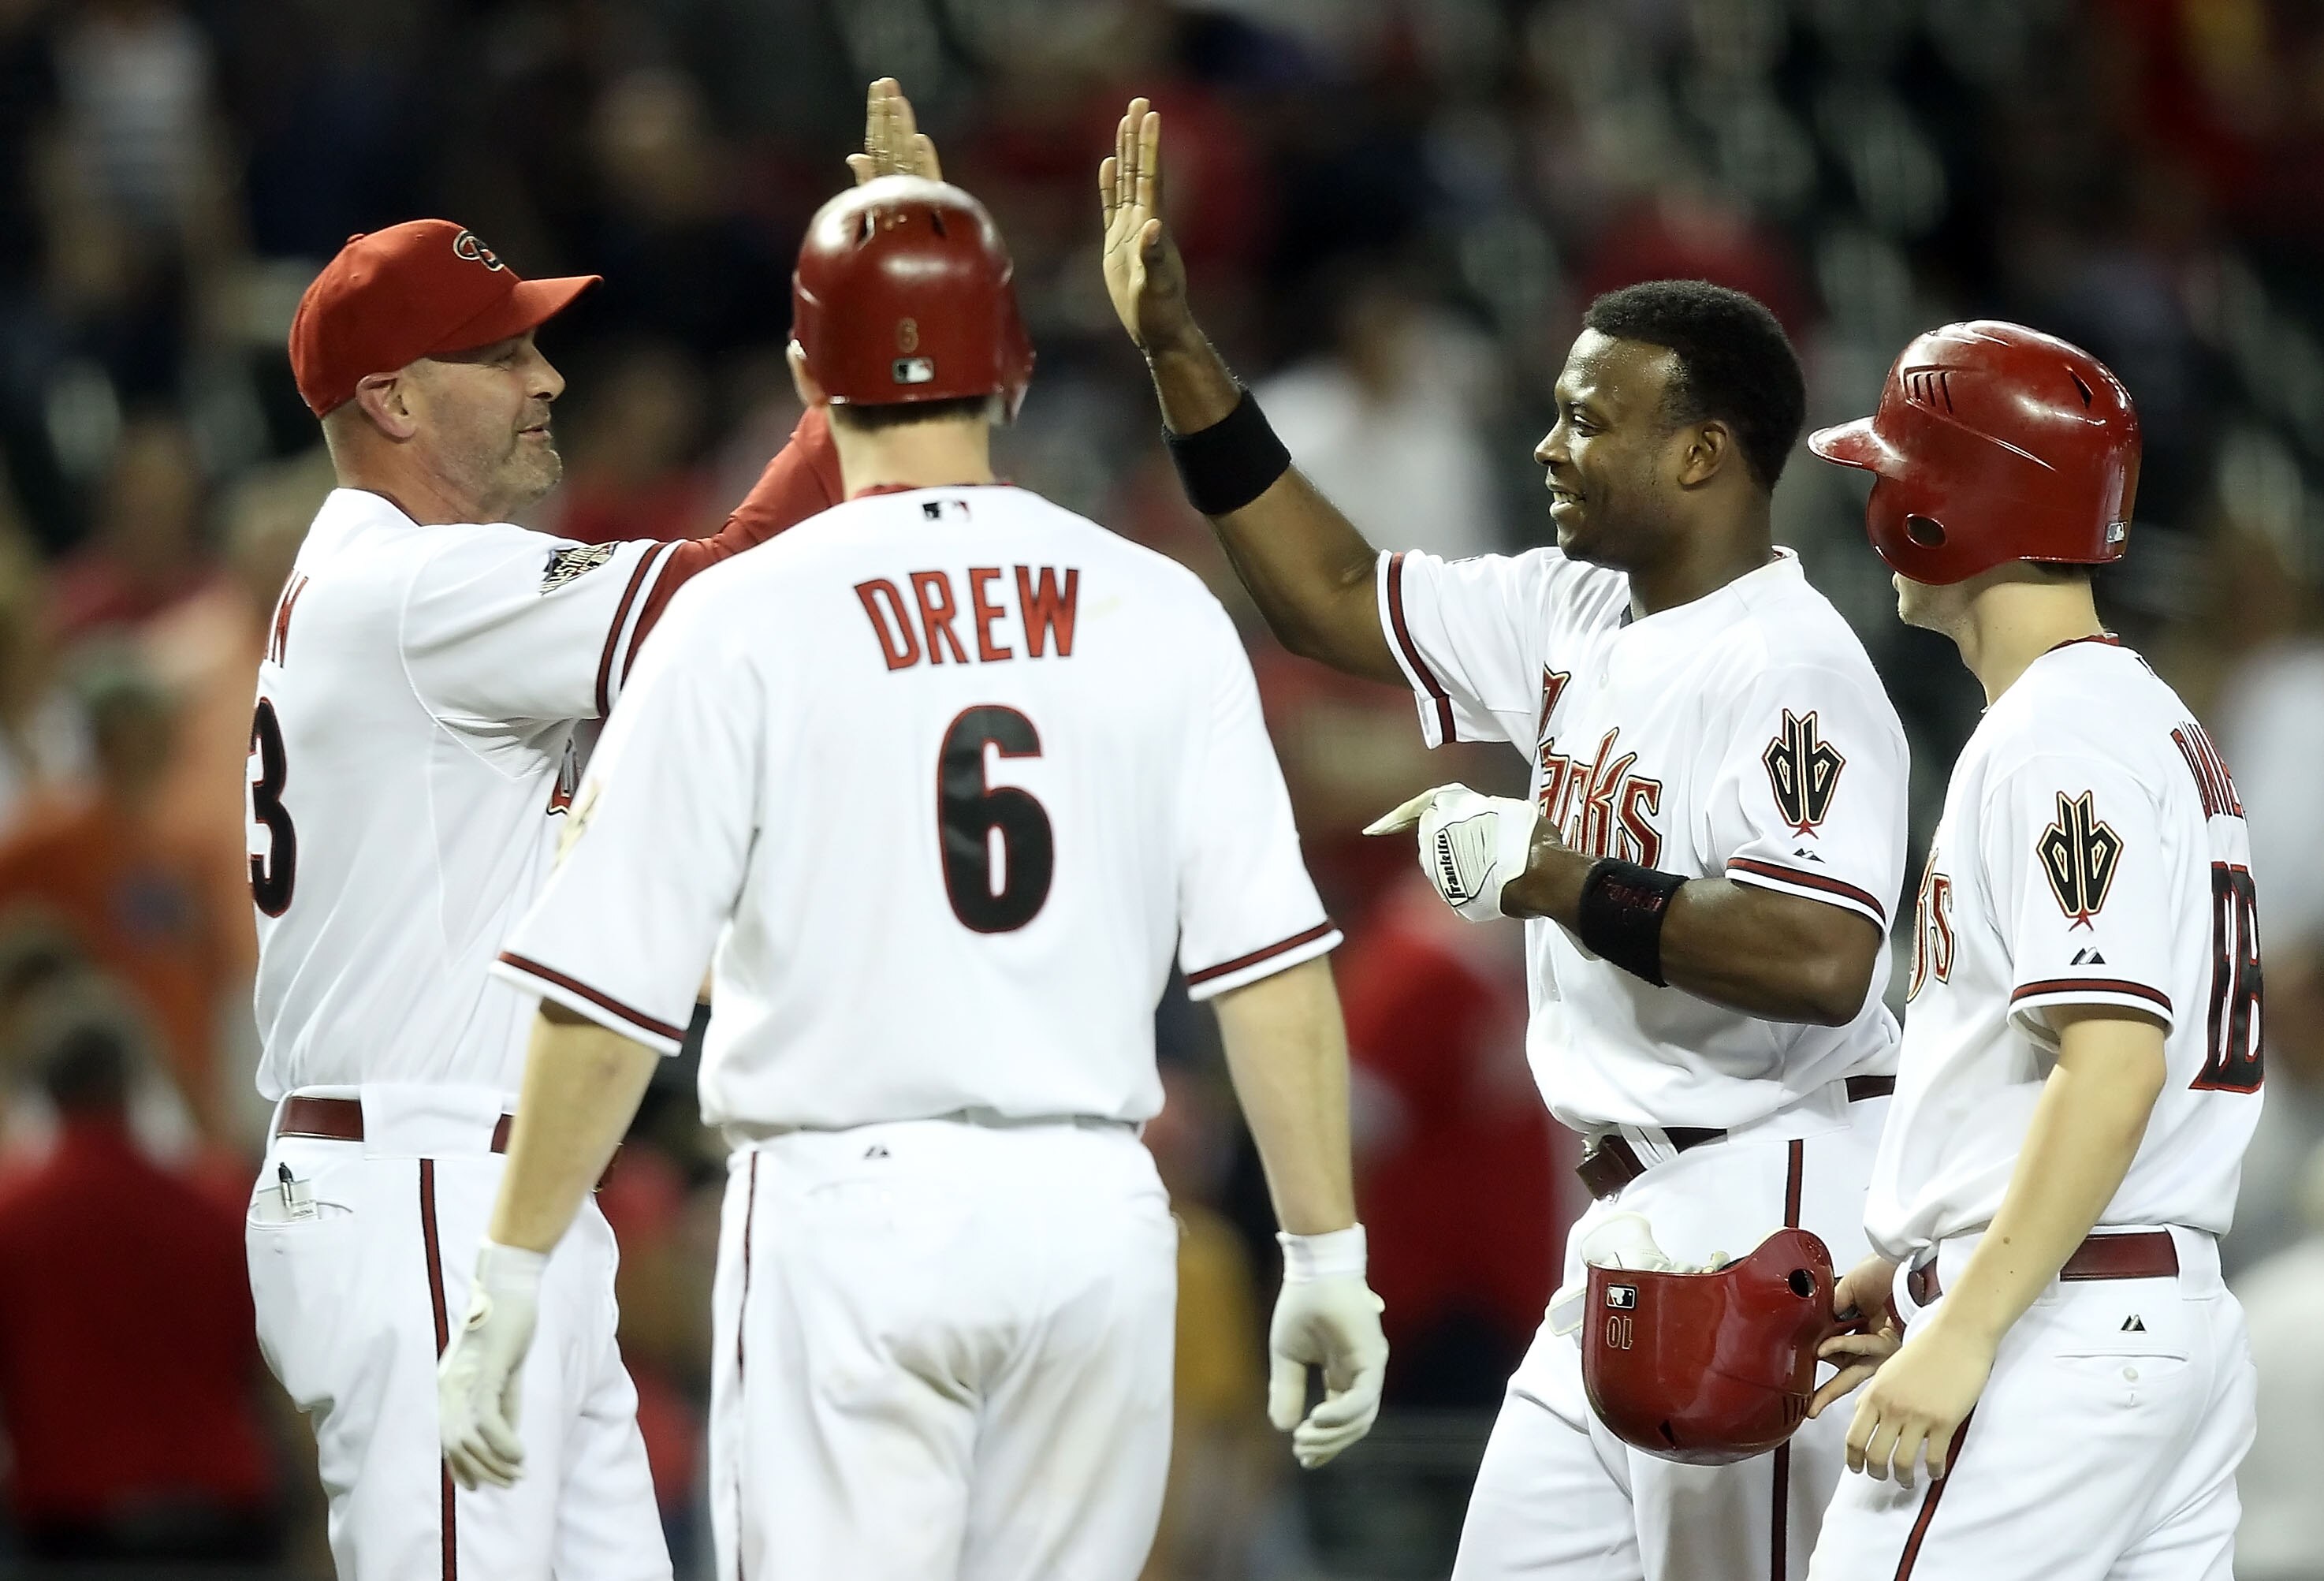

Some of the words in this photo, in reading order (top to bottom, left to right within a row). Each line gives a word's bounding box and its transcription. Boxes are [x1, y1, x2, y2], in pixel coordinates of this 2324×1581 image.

[854, 565, 1078, 670] DREW
[248, 696, 296, 919] 3
[937, 704, 1054, 933] 6
[1437, 833, 1467, 899] Franklin
[1606, 1315, 1633, 1350] 10
